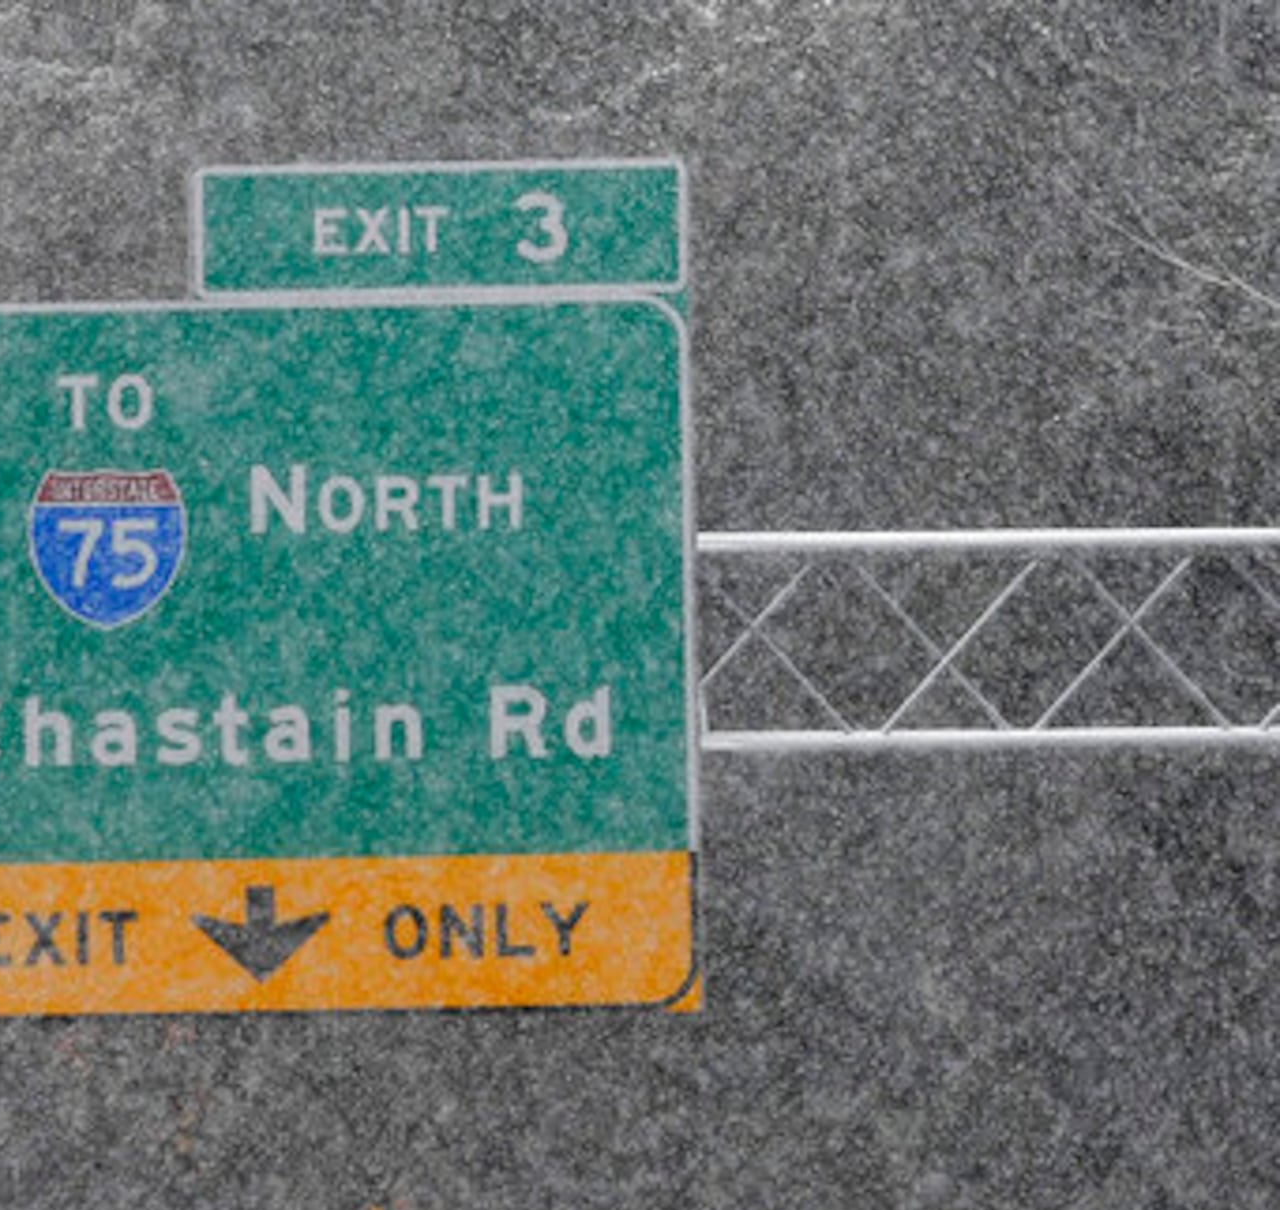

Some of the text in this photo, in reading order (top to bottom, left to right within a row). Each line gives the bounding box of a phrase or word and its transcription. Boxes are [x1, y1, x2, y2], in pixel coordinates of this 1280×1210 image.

[312, 191, 570, 264] EXIT 3
[57, 373, 153, 431] TO
[58, 518, 158, 590] 75
[490, 685, 614, 760] Rd
[383, 901, 590, 960] ONLY
